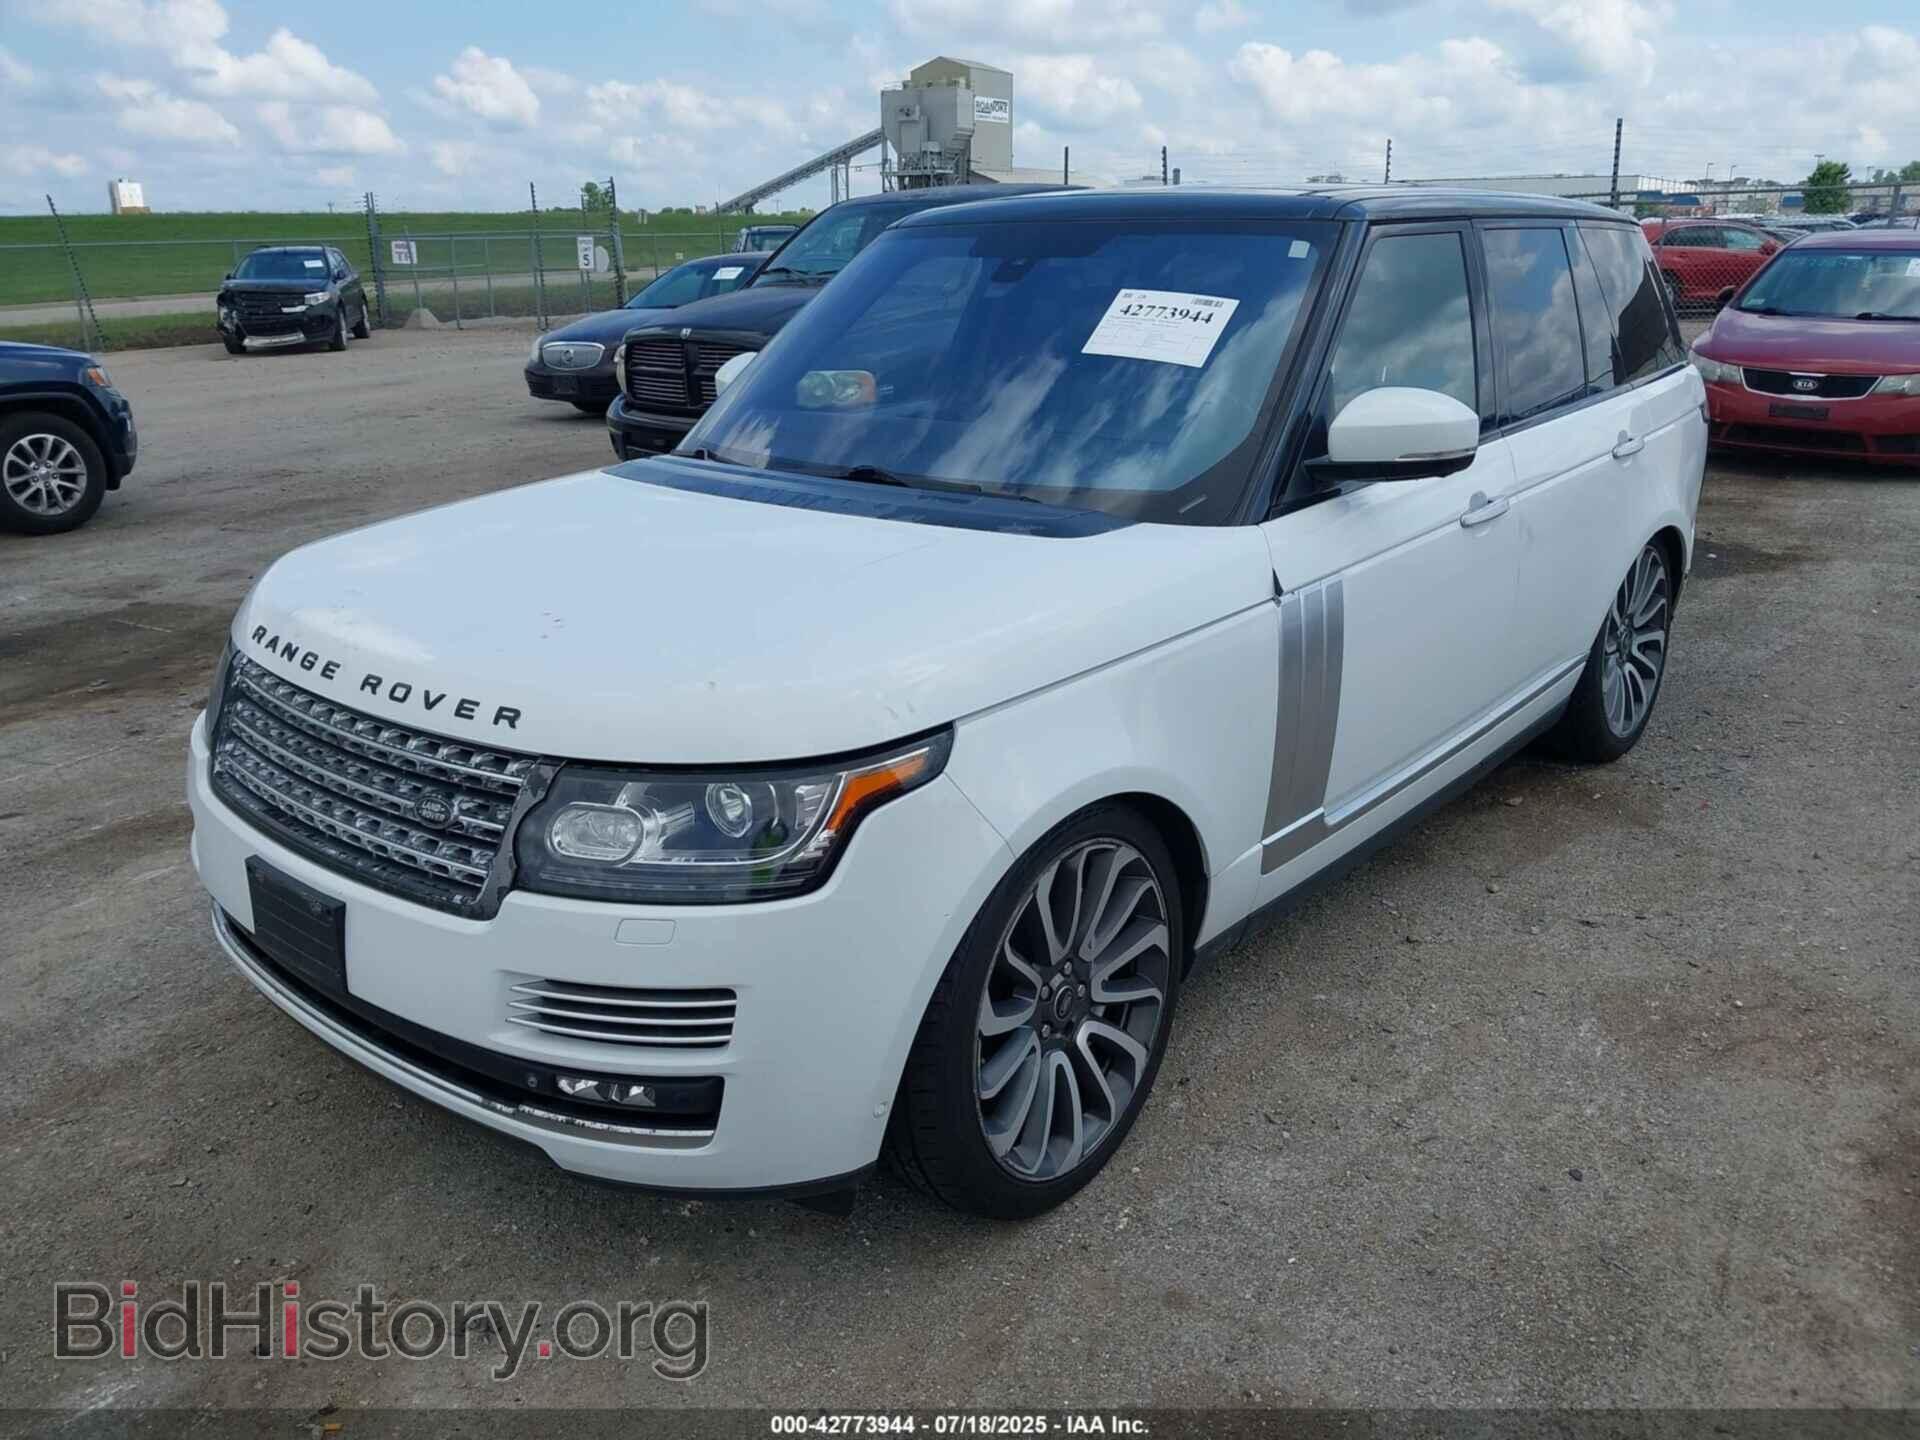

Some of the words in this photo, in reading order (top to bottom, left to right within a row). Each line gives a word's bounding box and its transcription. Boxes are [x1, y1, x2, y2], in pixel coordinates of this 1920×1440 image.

[583, 254, 590, 266] 5
[1119, 303, 1214, 325] 42773944
[251, 625, 341, 681] RANGE
[360, 673, 522, 729] ROVER
